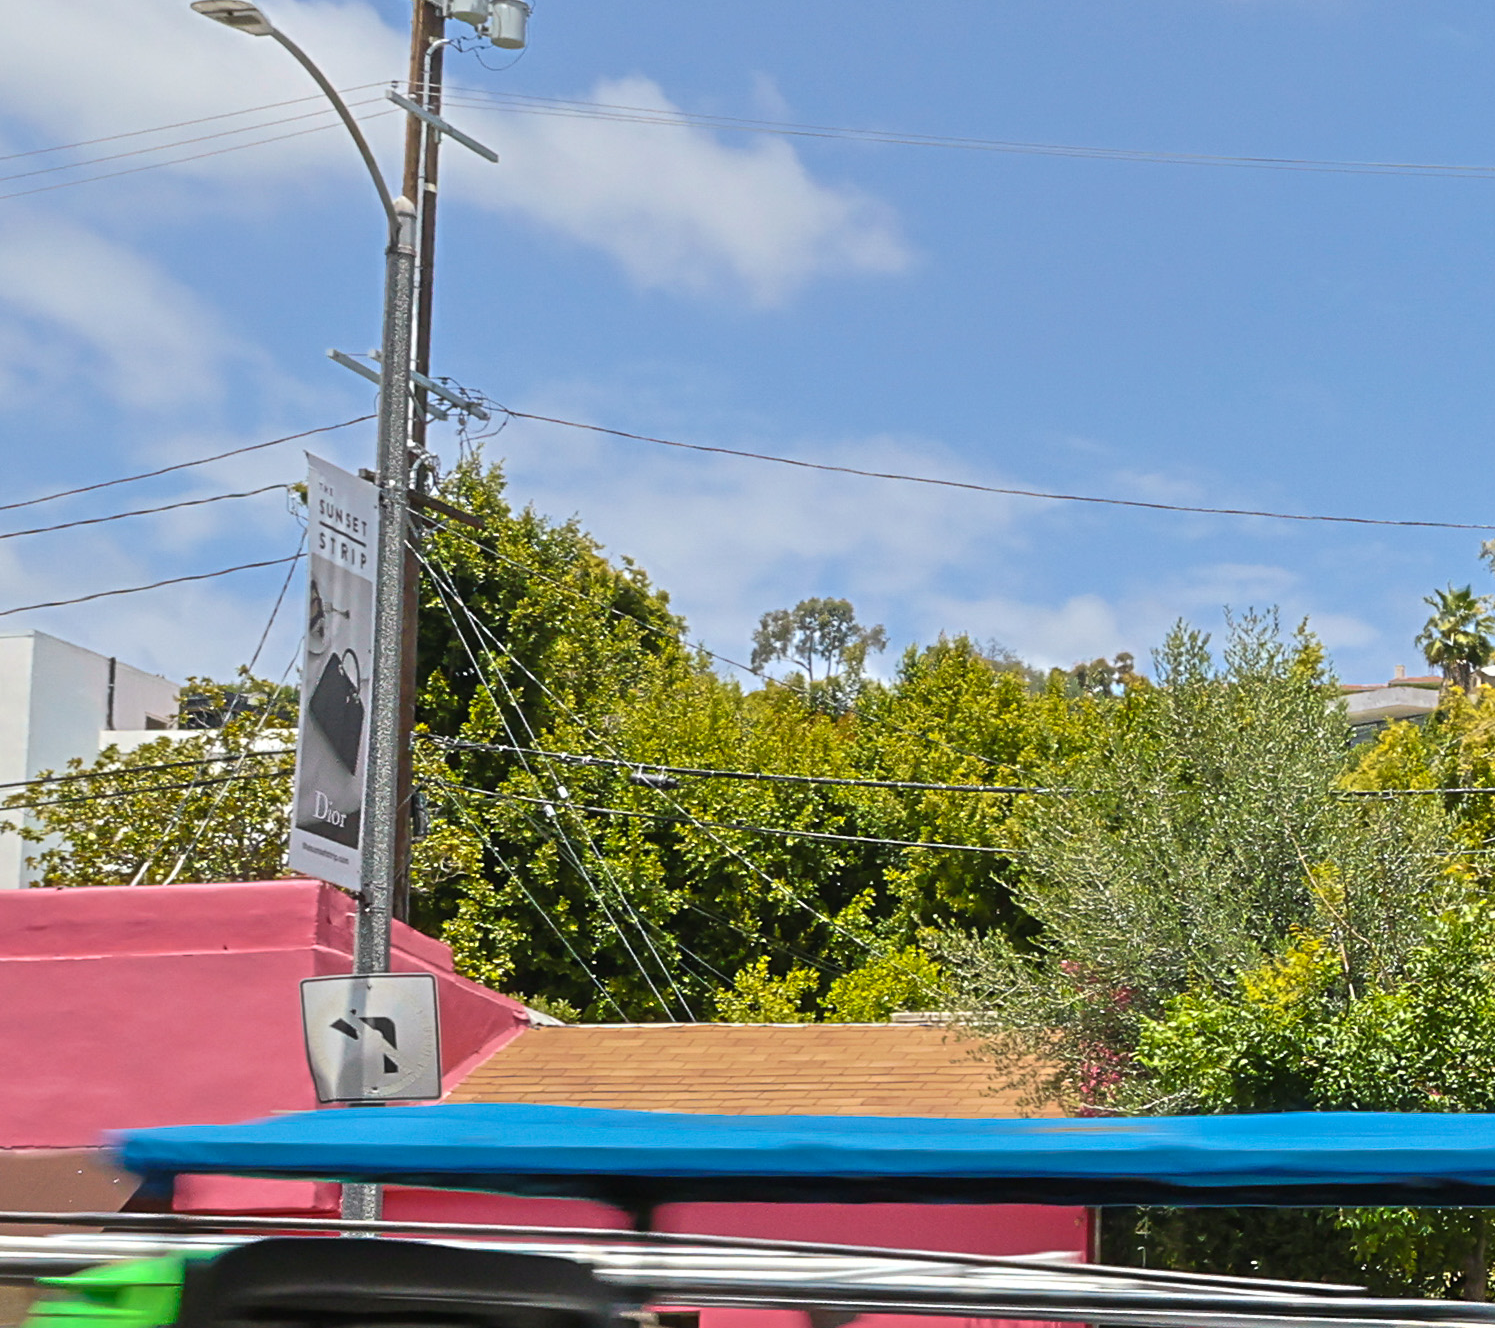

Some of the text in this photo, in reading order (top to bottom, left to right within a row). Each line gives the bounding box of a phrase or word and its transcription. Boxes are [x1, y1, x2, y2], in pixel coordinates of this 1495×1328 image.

[319, 499, 367, 537] SUNSET
[319, 532, 367, 569] STRIP
[312, 790, 347, 828] Dior
